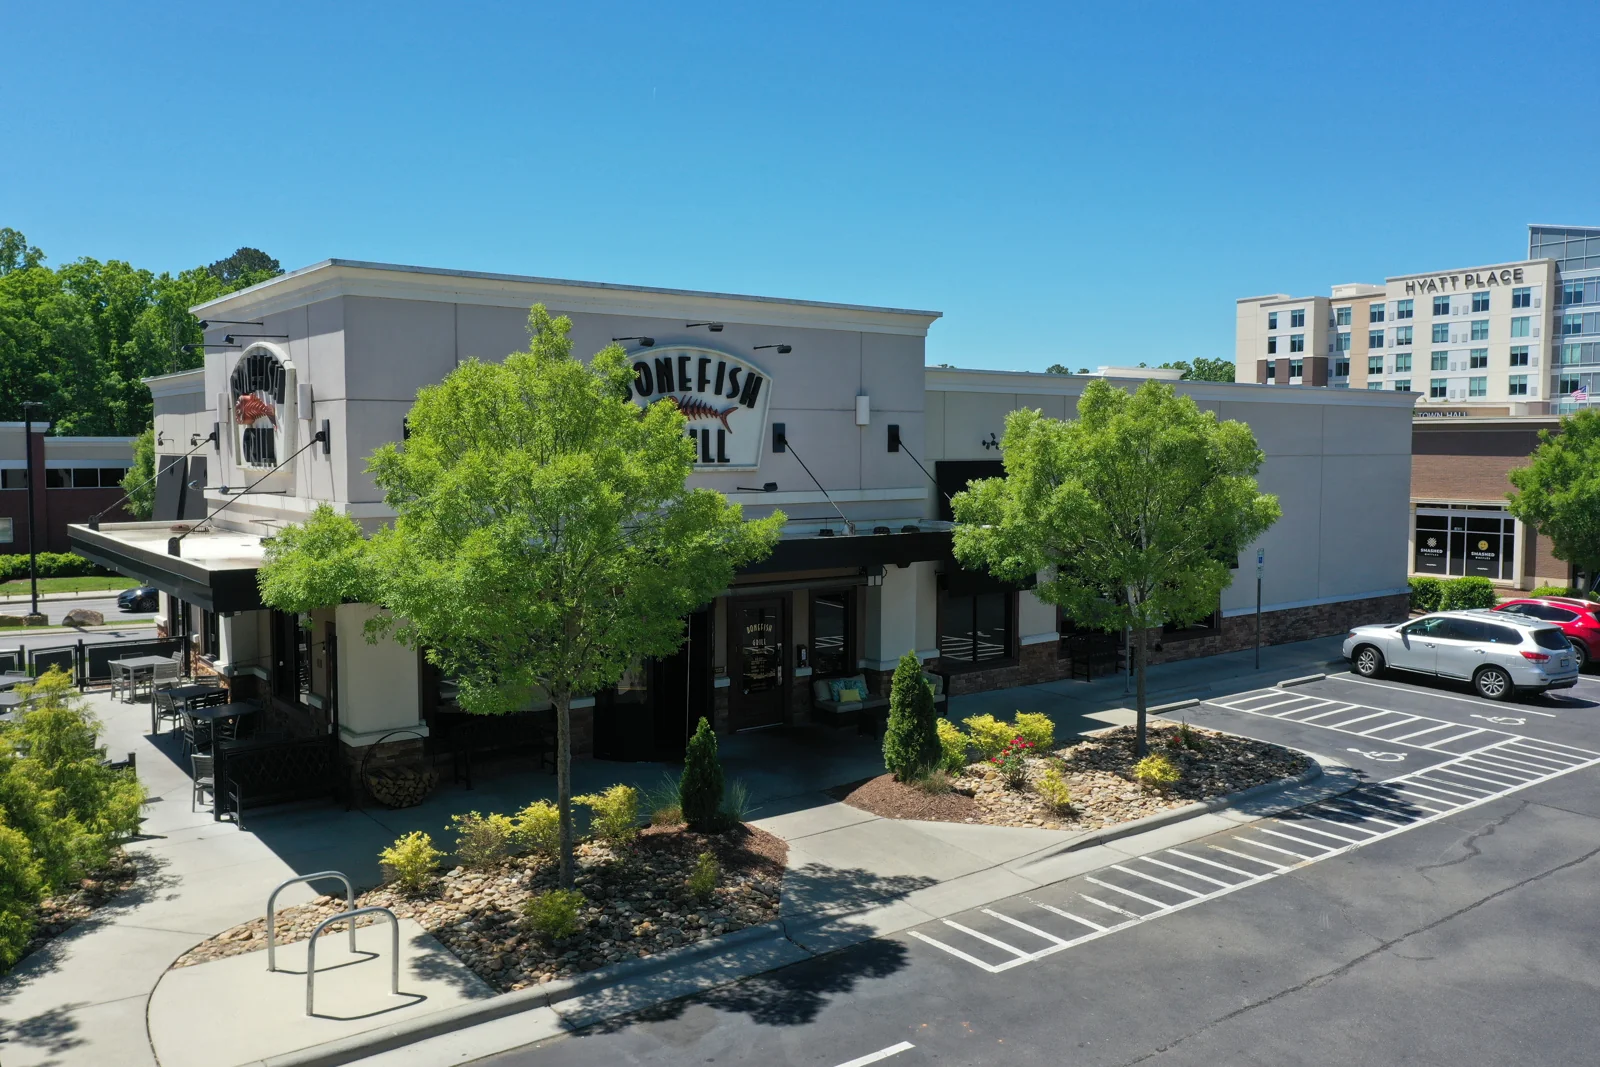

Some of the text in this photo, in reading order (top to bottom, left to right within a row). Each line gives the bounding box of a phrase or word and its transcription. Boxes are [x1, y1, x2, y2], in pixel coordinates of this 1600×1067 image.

[1405, 267, 1523, 293] HYATT PLACE
[623, 356, 763, 408] ONEFISH
[689, 429, 730, 463] ILL
